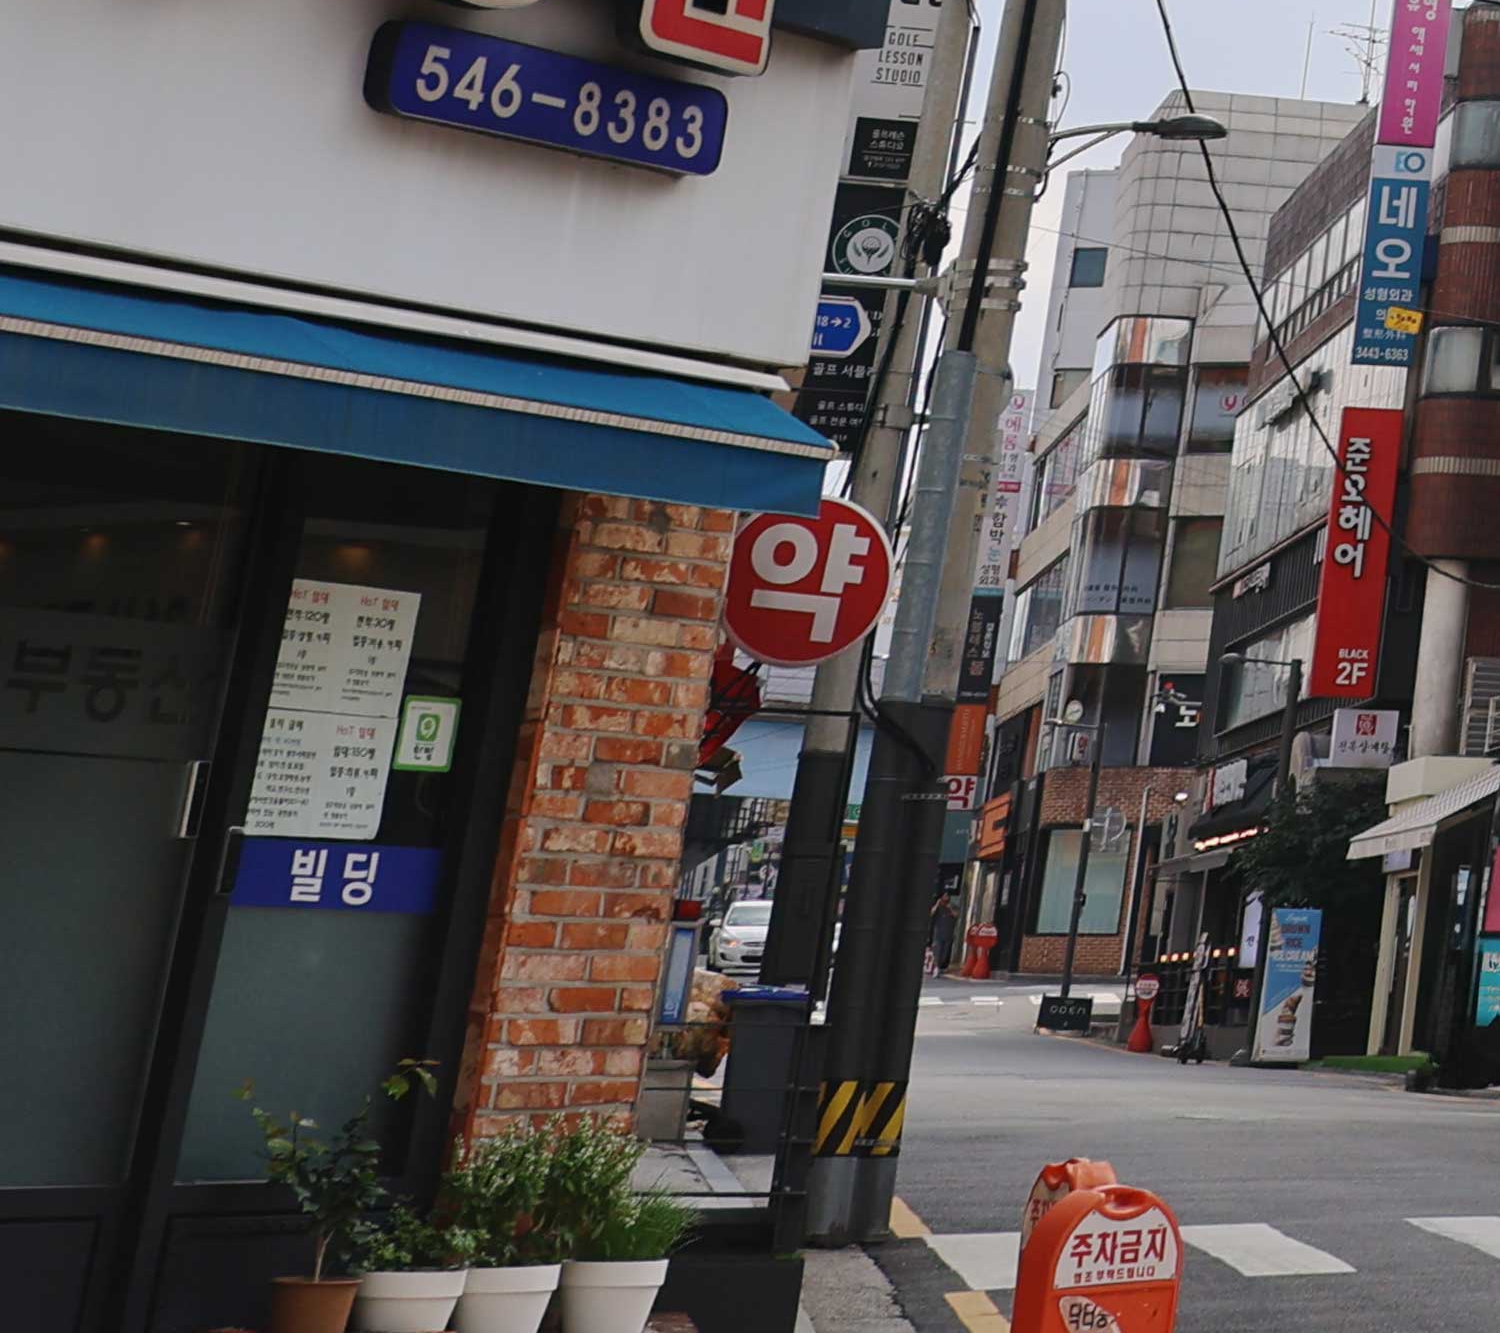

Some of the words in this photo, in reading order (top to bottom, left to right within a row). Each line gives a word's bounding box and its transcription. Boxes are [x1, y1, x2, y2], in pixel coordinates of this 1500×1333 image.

[876, 67, 921, 84] STUDIO
[878, 50, 923, 66] LESSON
[414, 45, 704, 160] 546-8383
[1372, 187, 1417, 281] 네오
[1364, 285, 1413, 302] 성형외과
[1334, 437, 1372, 578] 준오헤어
[748, 521, 866, 644] 약
[1339, 649, 1368, 659] BLACK
[1336, 663, 1368, 686] 2F
[947, 777, 975, 809] 약
[290, 849, 380, 906] 빌딩
[1070, 1225, 1167, 1268] 주차금지
